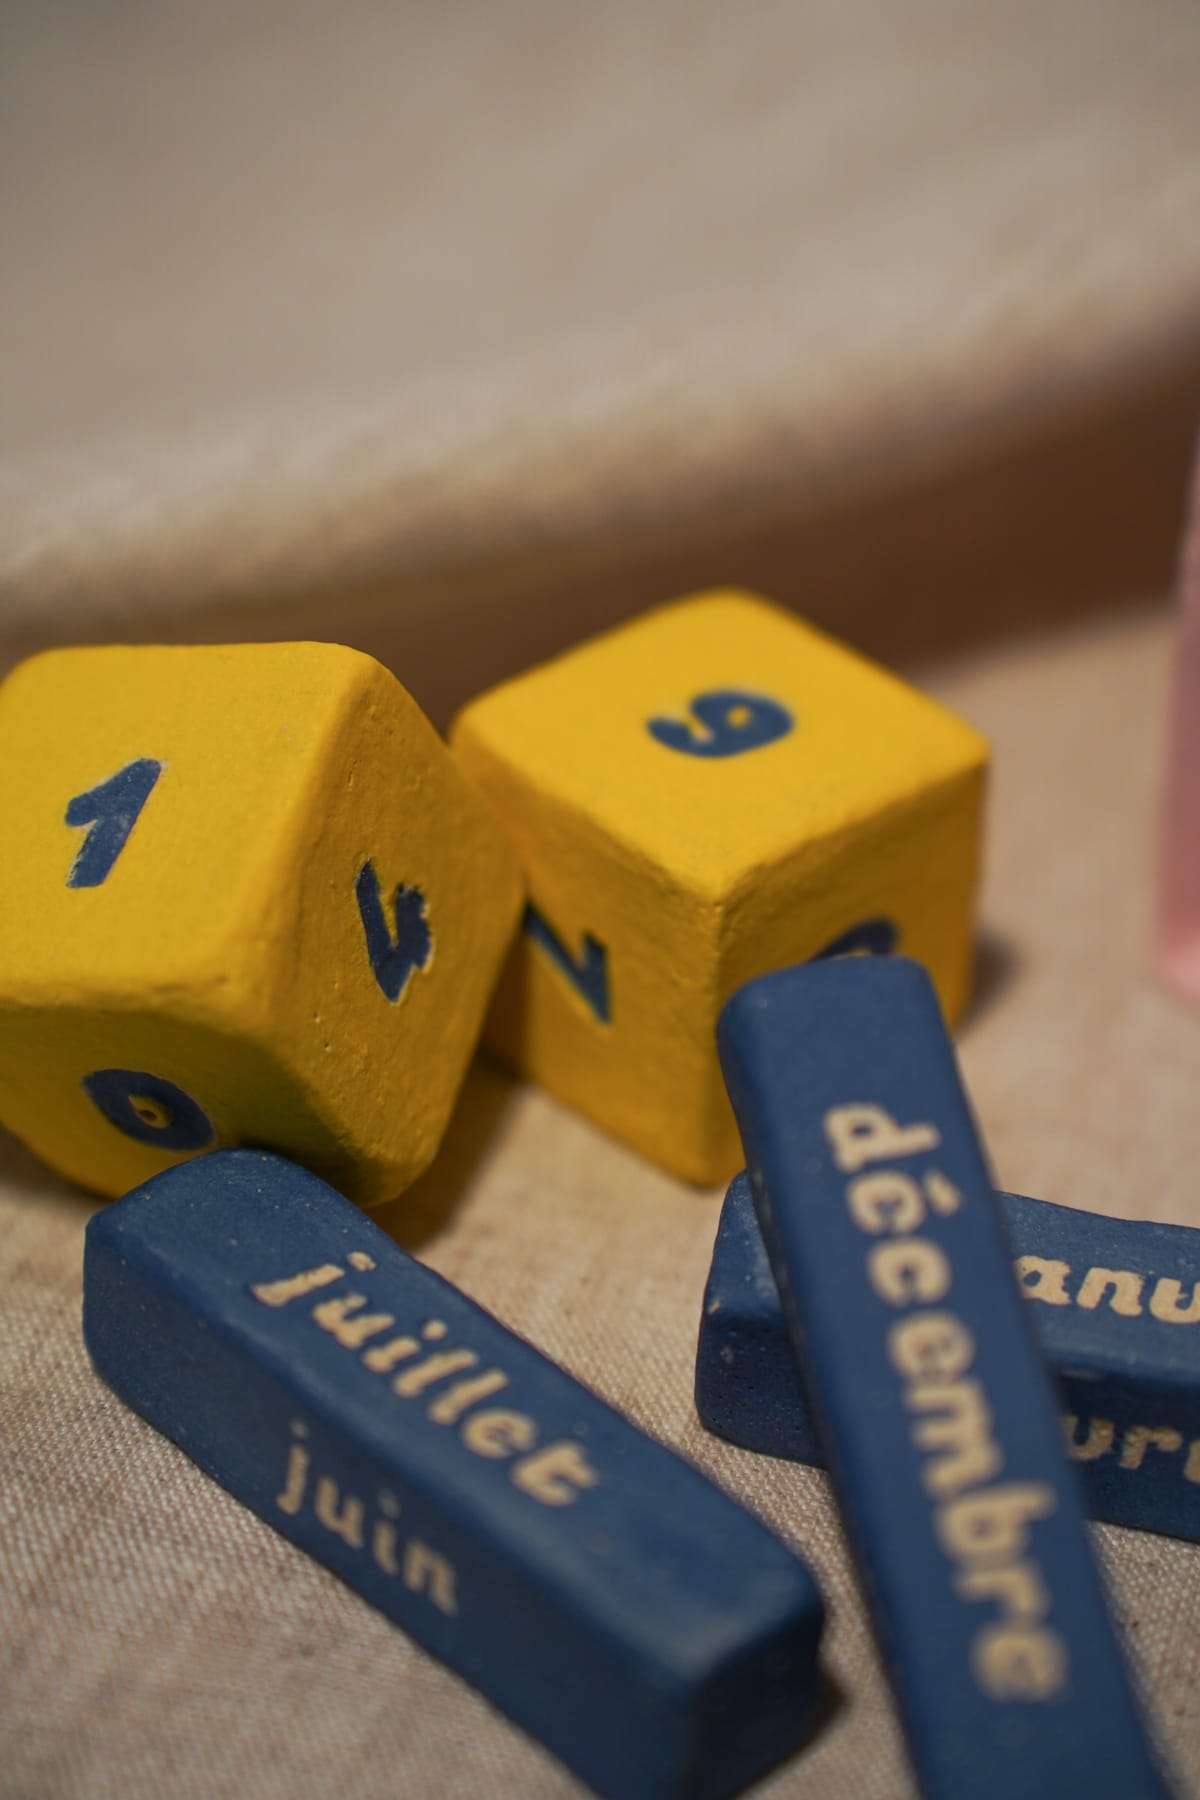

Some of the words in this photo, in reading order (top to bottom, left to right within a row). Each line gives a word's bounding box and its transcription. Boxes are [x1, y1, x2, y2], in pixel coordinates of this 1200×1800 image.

[66, 758, 163, 889] 1
[83, 1069, 215, 1153] 0
[250, 1251, 597, 1506] juillet
[823, 1101, 1068, 1702] décembre
[276, 1420, 459, 1616] juin
